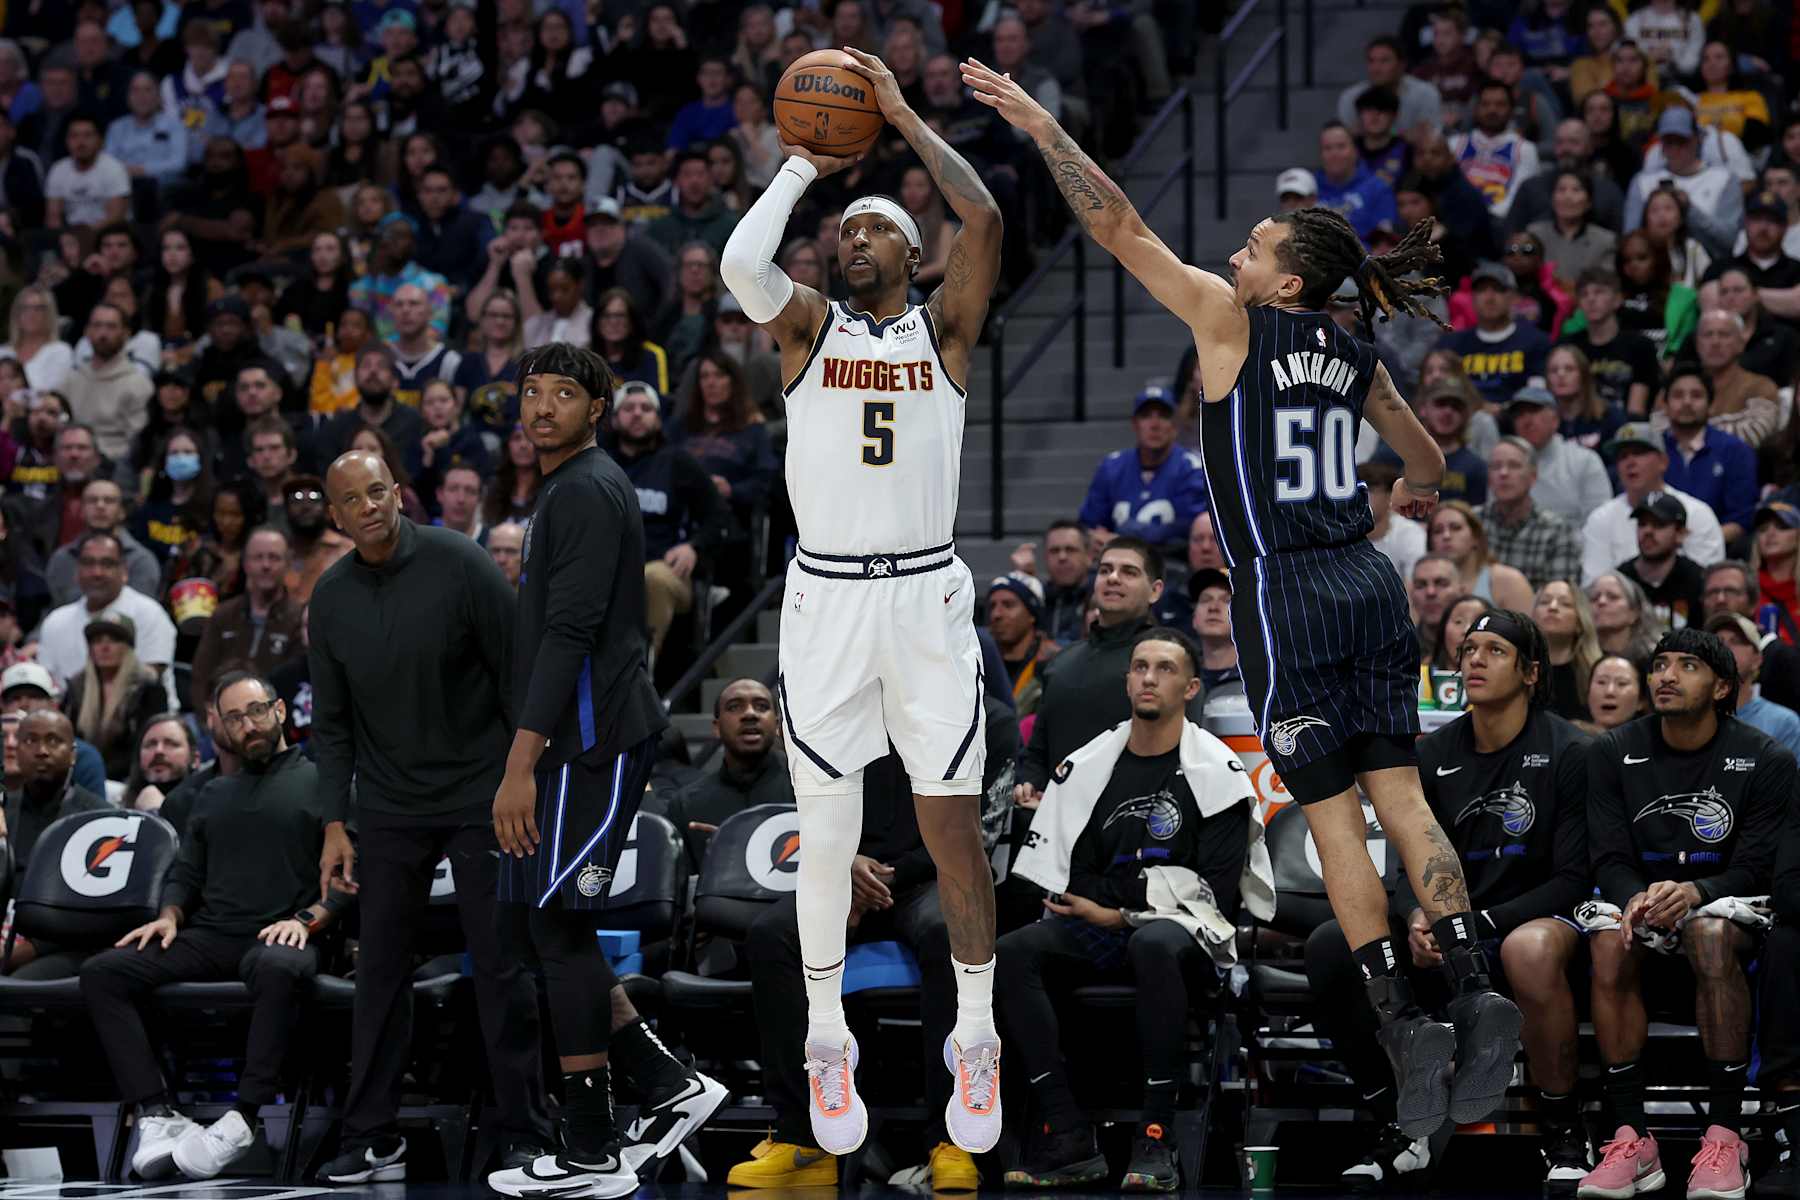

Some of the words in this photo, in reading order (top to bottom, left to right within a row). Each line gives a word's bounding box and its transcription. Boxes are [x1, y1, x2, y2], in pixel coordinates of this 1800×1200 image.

[794, 75, 866, 105] Wilson
[1059, 161, 1105, 210] Gregory
[892, 319, 916, 335] WU
[895, 330, 920, 342] Western
[899, 336, 918, 345] Union
[822, 357, 934, 392] NUGGETS
[1271, 351, 1359, 397] ANTHONY
[861, 400, 896, 468] 5
[1273, 406, 1358, 503] 50
[60, 816, 145, 897] G
